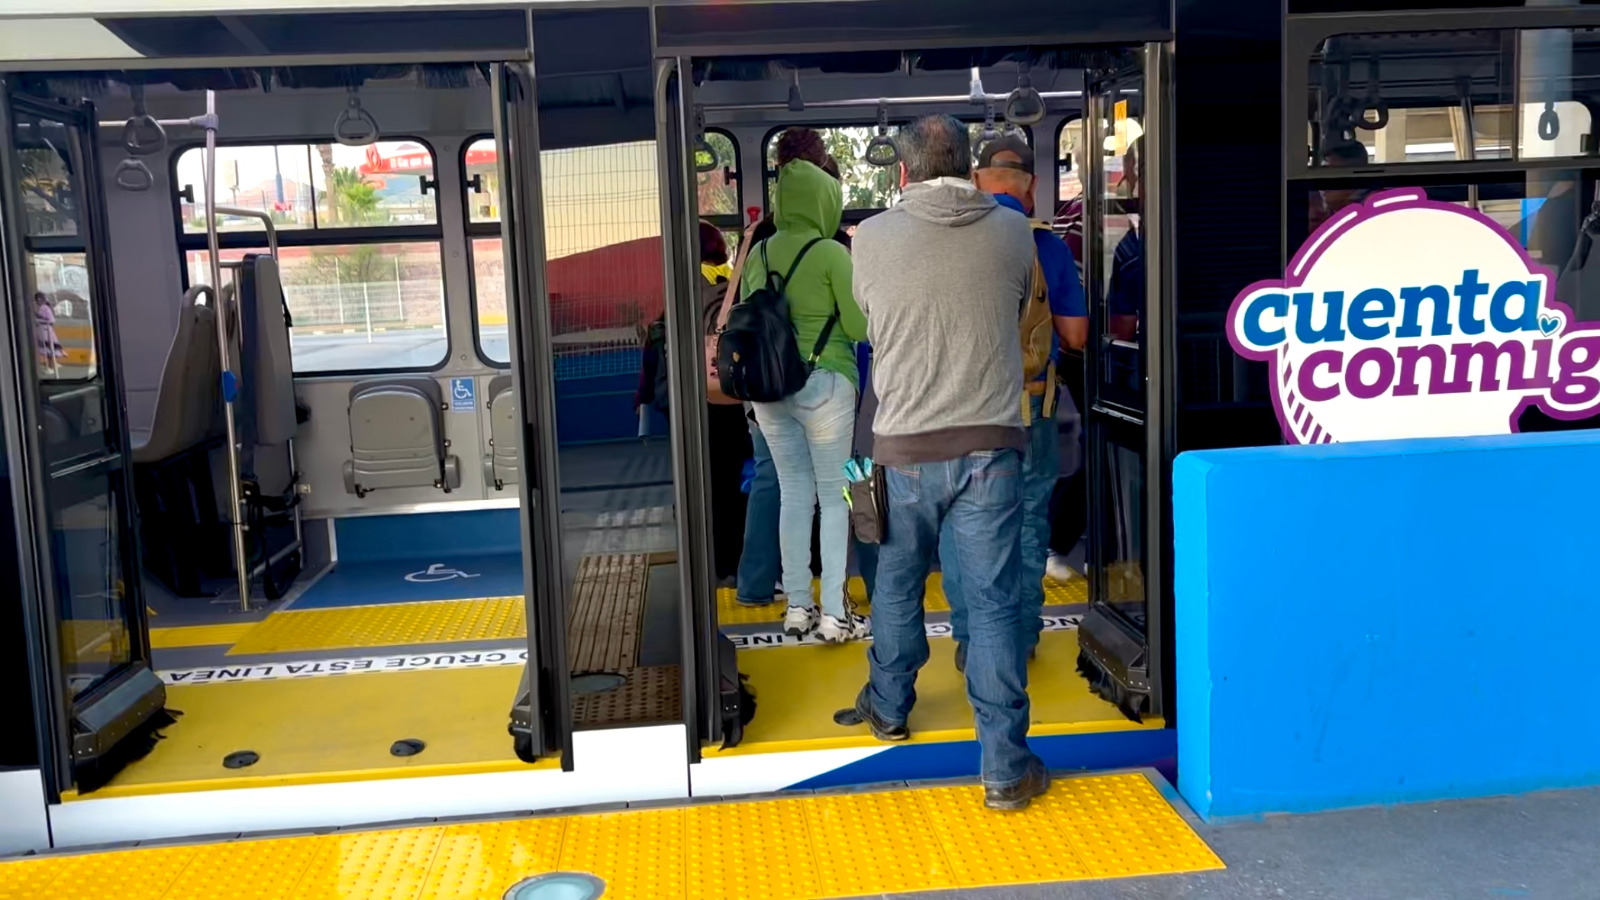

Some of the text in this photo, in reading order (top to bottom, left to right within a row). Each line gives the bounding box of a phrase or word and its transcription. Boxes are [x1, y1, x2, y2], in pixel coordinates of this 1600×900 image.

[1243, 268, 1542, 347] cuenta
[1297, 336, 1600, 405] conmig
[286, 659, 374, 674] ESTA
[385, 652, 507, 668] CRUCE
[169, 666, 274, 681] LINEA
